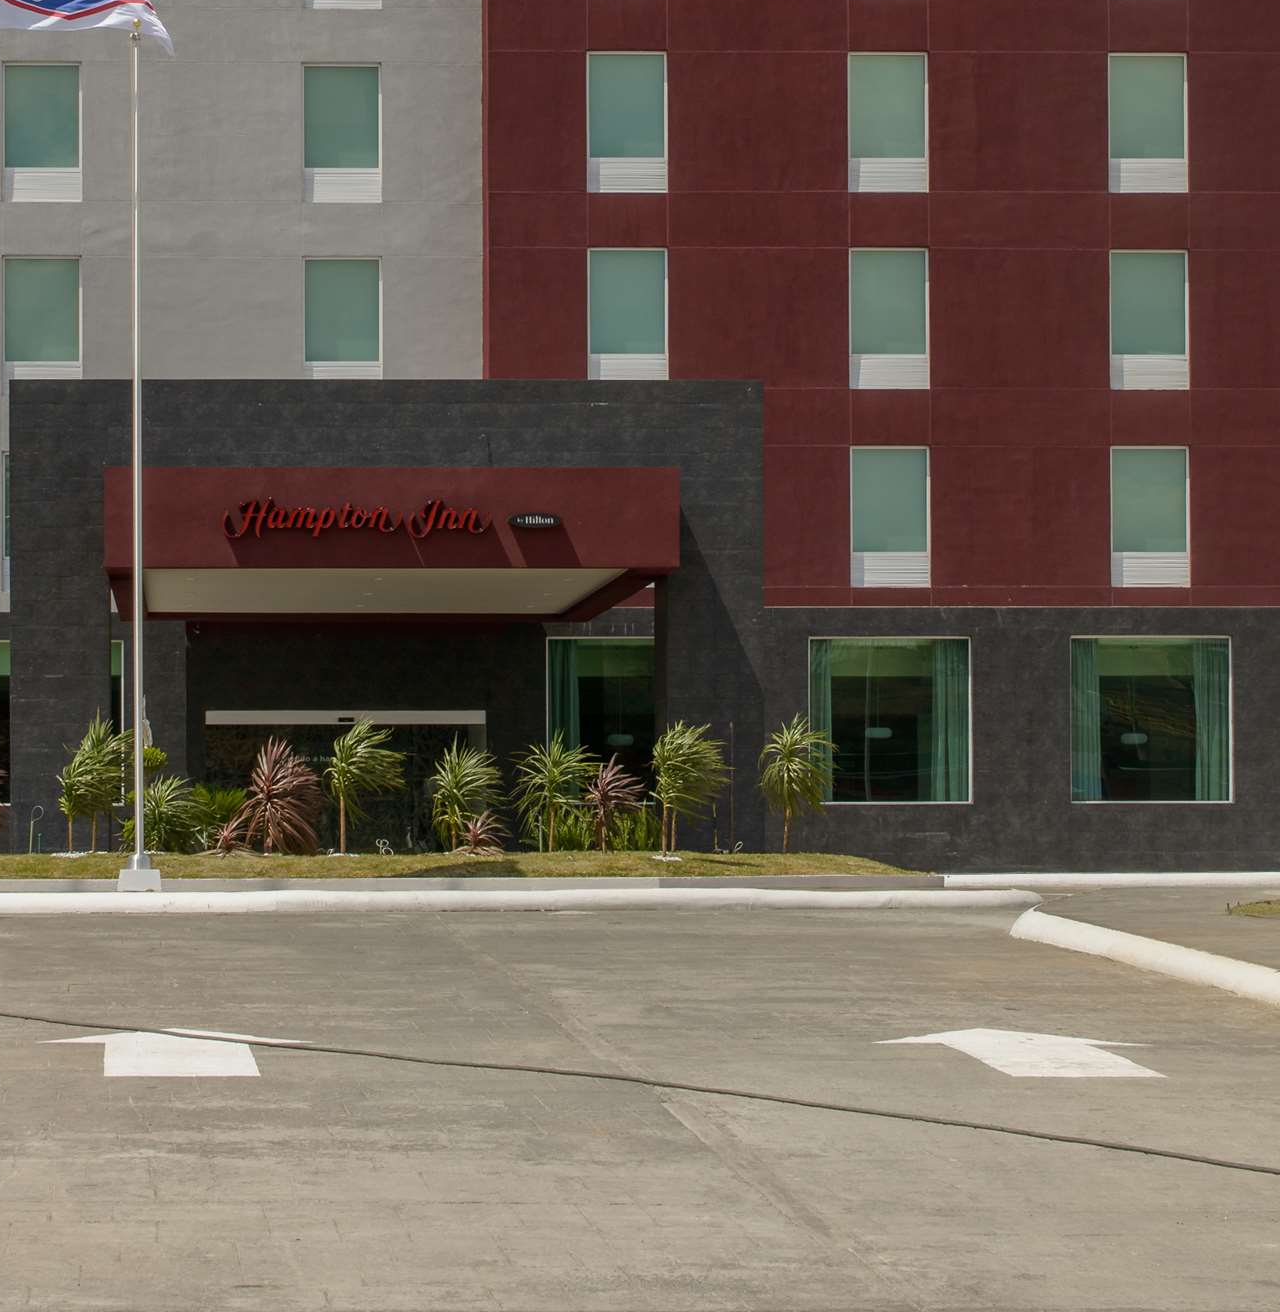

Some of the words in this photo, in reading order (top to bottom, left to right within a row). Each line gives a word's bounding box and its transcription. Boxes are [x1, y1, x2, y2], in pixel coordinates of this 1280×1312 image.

[223, 496, 404, 539] Hampton
[407, 498, 492, 539] Inn
[525, 515, 554, 524] Hilton
